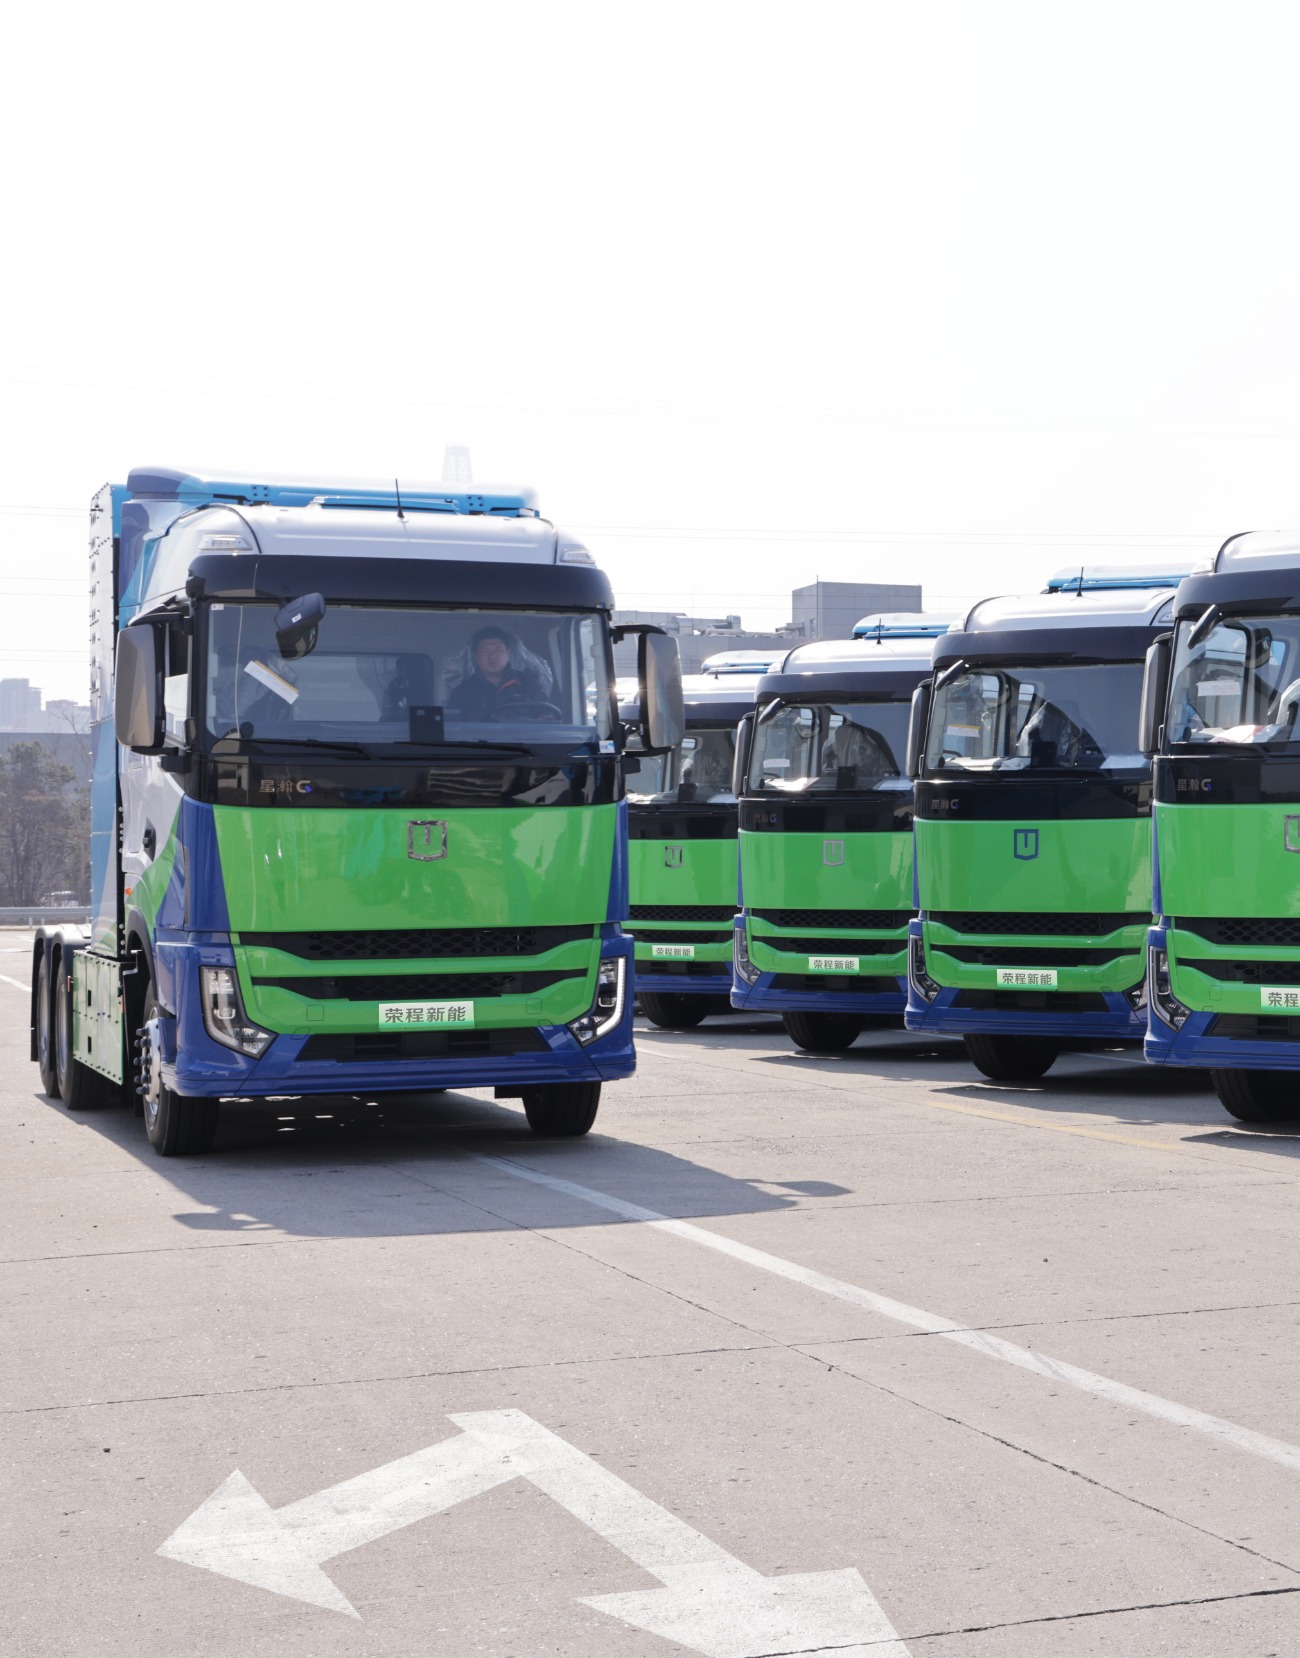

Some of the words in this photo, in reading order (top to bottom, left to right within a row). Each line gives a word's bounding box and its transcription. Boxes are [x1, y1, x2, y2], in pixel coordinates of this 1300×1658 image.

[813, 959, 855, 971] 荣程新能
[1002, 972, 1052, 986] 荣程新能
[384, 1006, 466, 1024] 荣程新能
